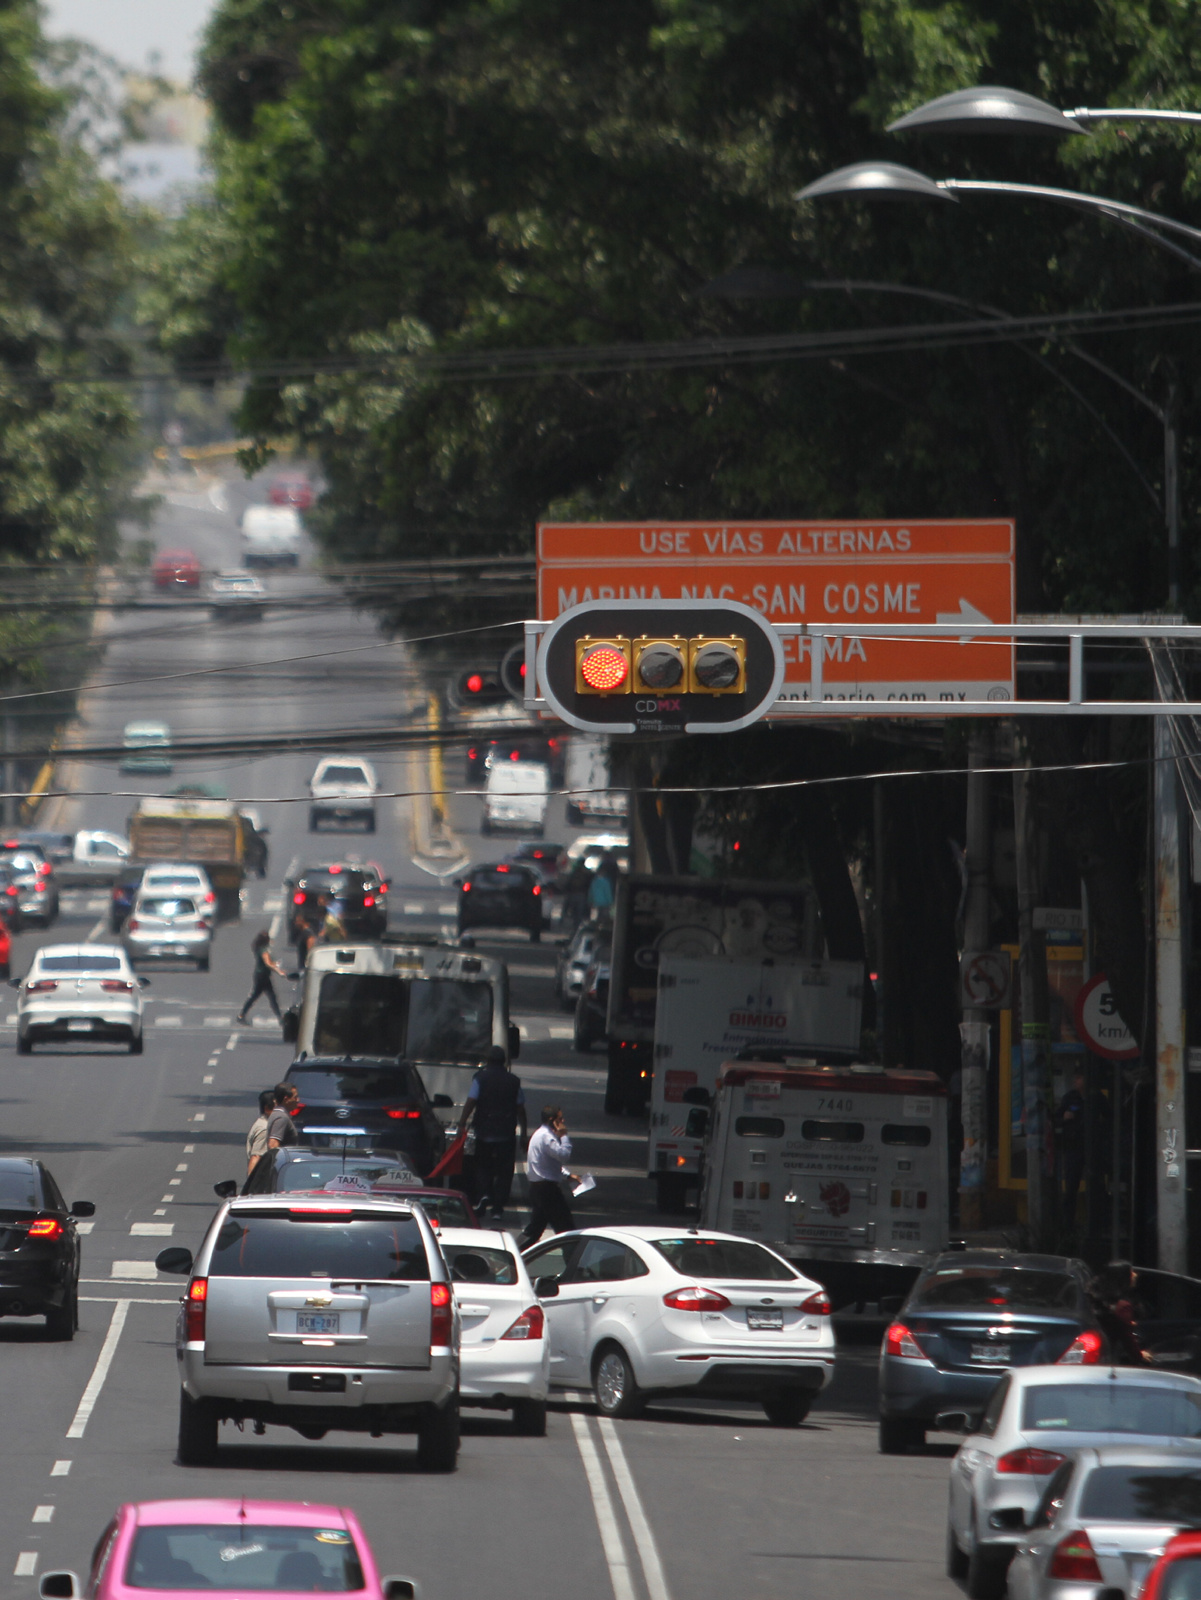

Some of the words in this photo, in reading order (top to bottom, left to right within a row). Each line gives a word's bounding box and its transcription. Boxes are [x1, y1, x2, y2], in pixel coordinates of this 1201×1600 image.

[639, 530, 691, 554] USE
[703, 526, 765, 554] VÍAS
[777, 528, 912, 554] ALTERNAS
[823, 583, 922, 614] COSME
[782, 635, 868, 664] ERMA
[635, 699, 681, 713] CDMX
[729, 1012, 787, 1028] BIMBO
[818, 1098, 853, 1112] 7440
[783, 1161, 824, 1170] QUEJAS
[336, 1176, 358, 1185] TAXI
[389, 1171, 412, 1181] TAXI
